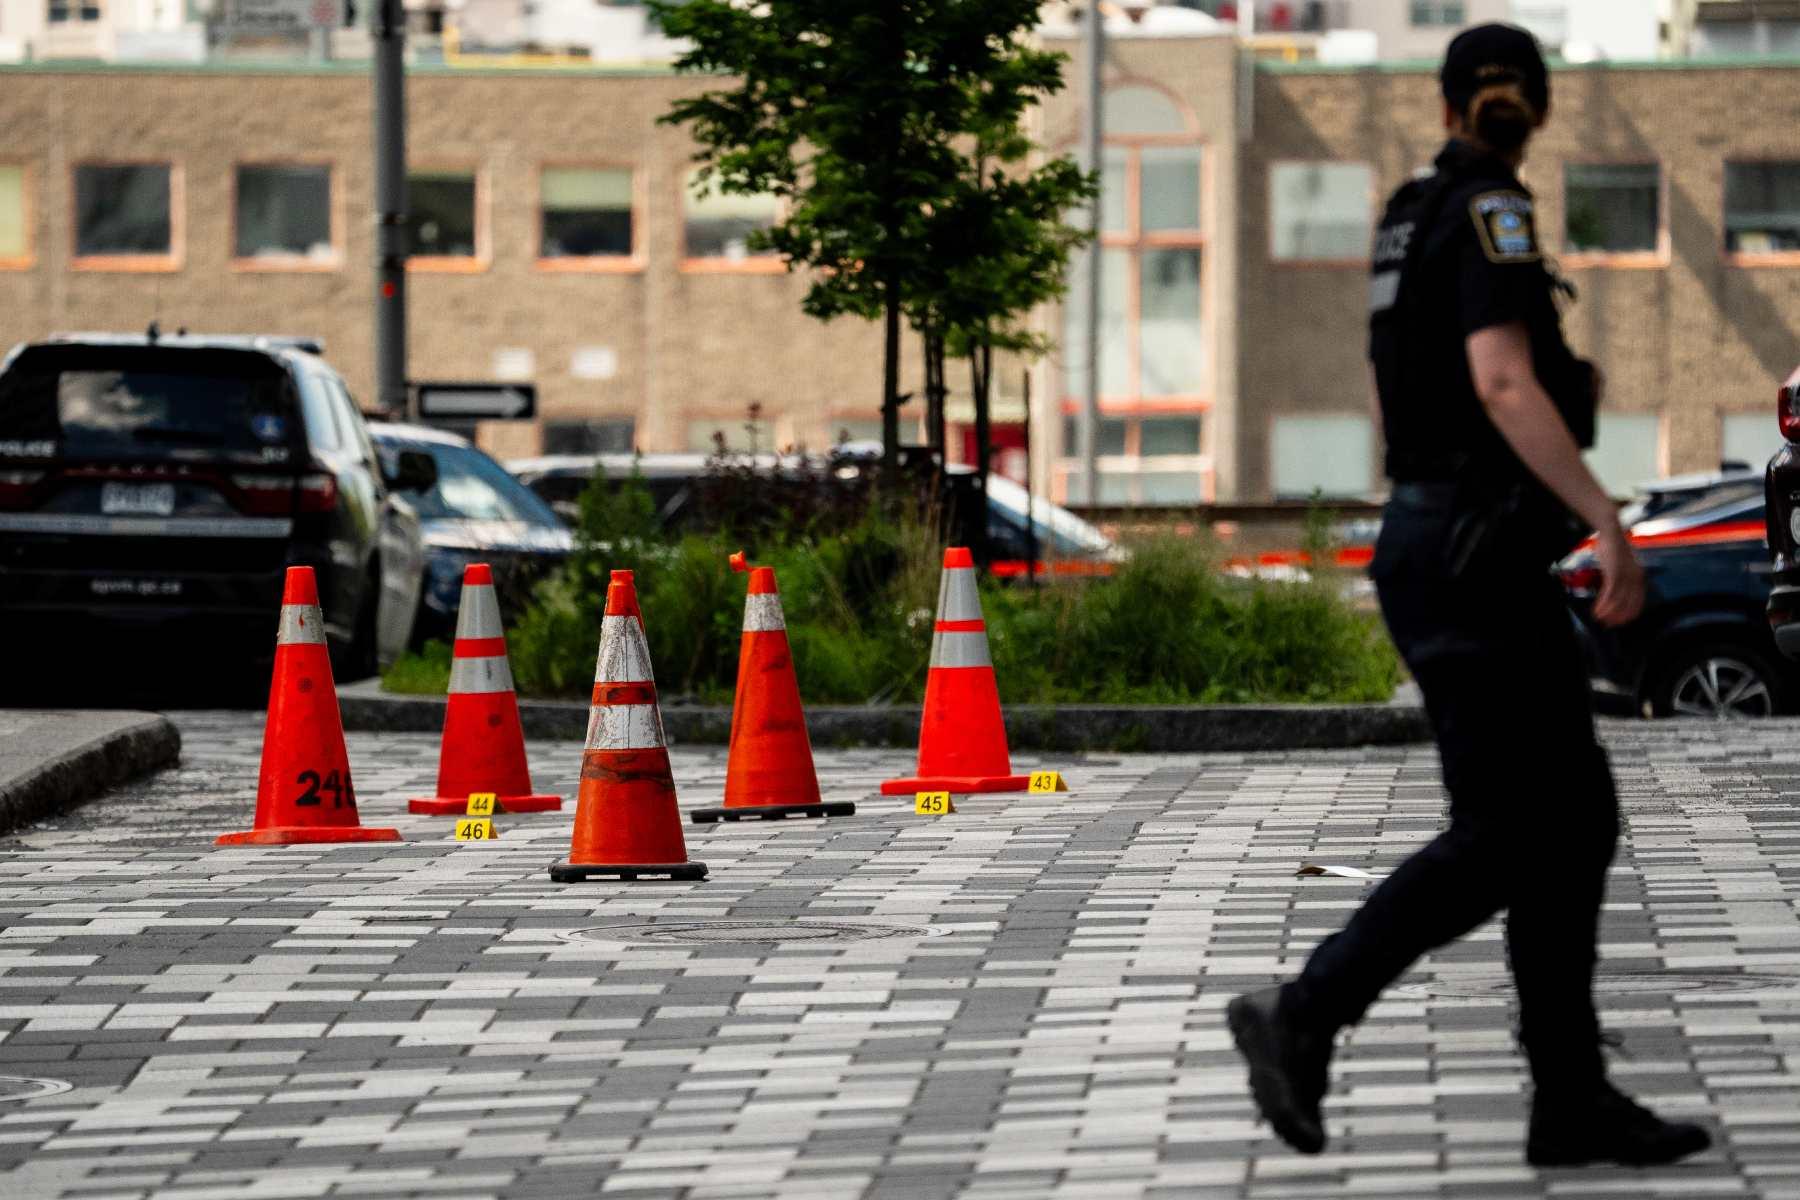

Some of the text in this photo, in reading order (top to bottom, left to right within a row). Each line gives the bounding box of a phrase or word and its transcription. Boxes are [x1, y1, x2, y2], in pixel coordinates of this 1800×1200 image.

[1034, 775, 1051, 790] 43
[472, 797, 488, 810] 44
[921, 796, 942, 811] 45
[461, 823, 483, 839] 46
